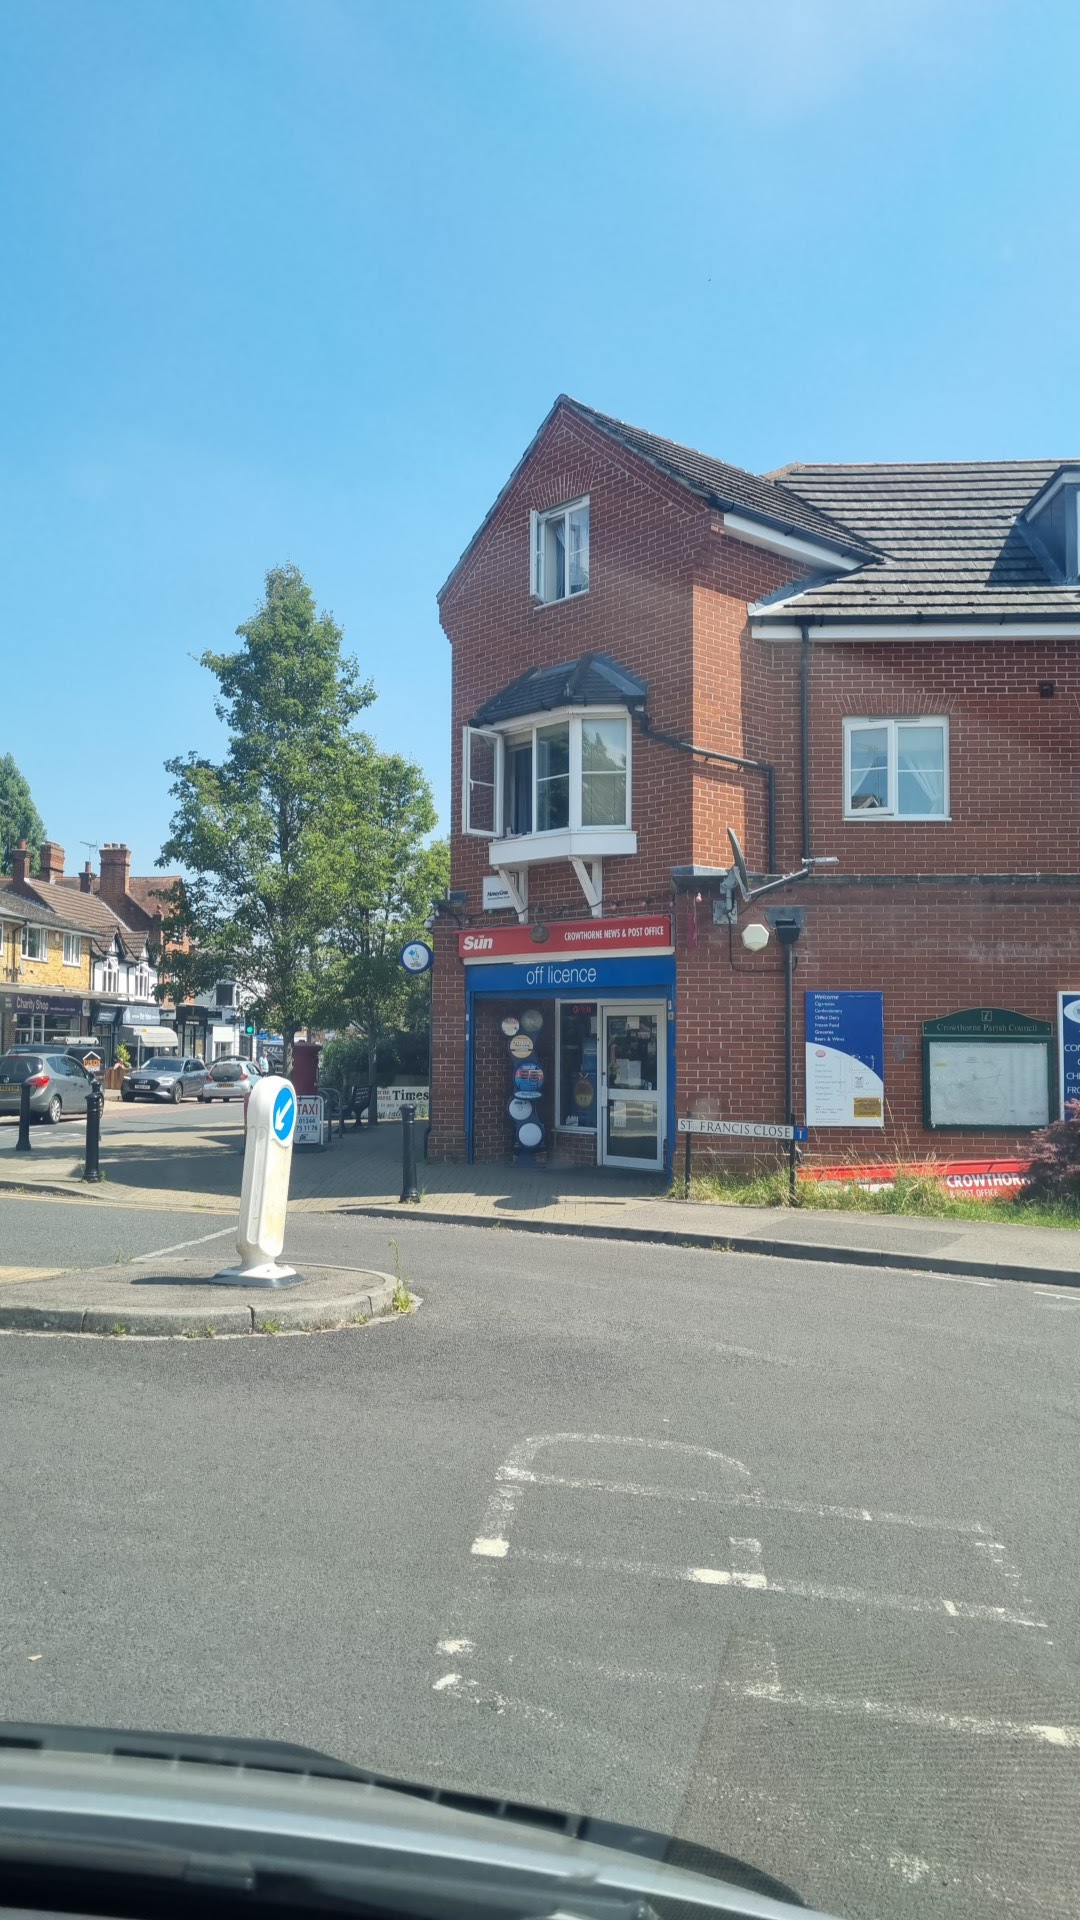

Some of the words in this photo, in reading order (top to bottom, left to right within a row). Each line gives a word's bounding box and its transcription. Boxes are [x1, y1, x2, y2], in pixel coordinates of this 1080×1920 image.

[564, 930, 602, 941] CROWTHORNE
[604, 928, 620, 939] NEWS
[622, 928, 627, 937] &
[628, 927, 643, 937] POST
[644, 926, 664, 936] OFFICE
[463, 936, 493, 950] Sun
[526, 966, 543, 985] off
[547, 965, 597, 985] licence
[16, 997, 36, 1011] Charity
[36, 1000, 49, 1012] Shop
[936, 1023, 981, 1032] Crowthorne
[983, 1023, 1007, 1032] Parish
[1008, 1023, 1038, 1032] Council
[392, 1089, 429, 1101] Times
[297, 1104, 318, 1115] TAXI
[700, 1121, 750, 1135] FRANCIS
[753, 1125, 791, 1138] CLOSE
[976, 1187, 999, 1198] OFFICE
